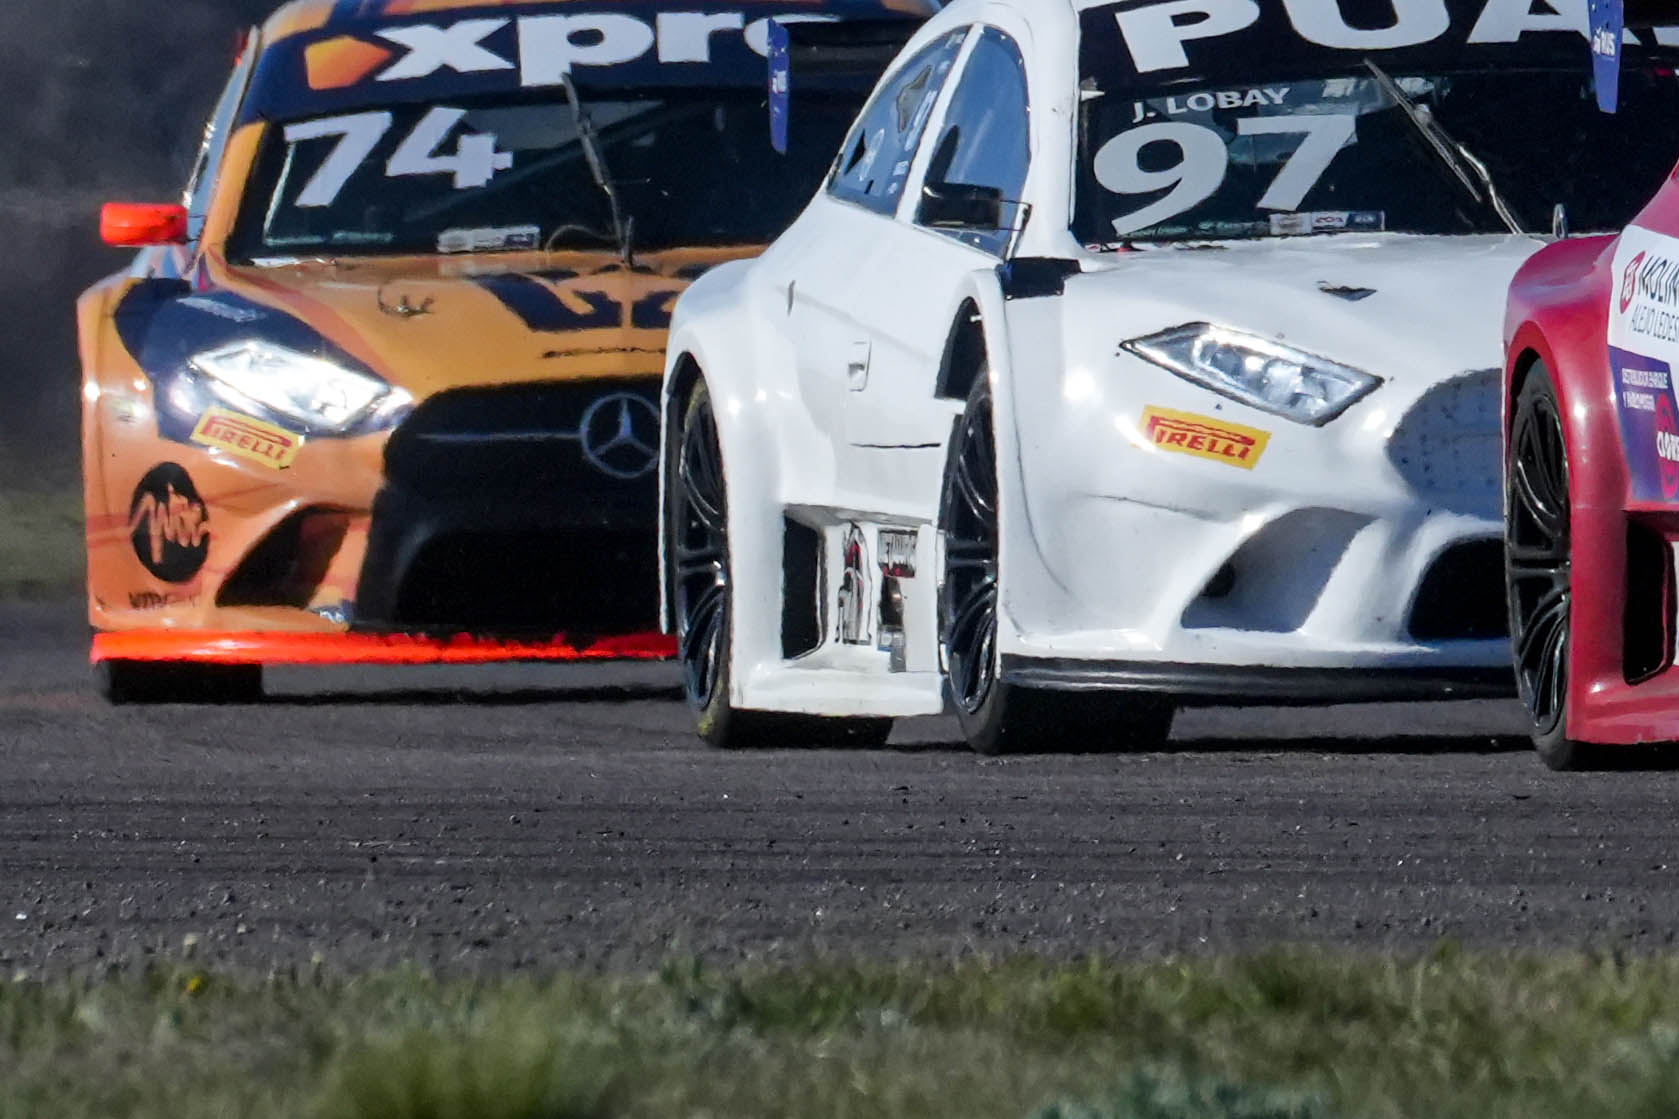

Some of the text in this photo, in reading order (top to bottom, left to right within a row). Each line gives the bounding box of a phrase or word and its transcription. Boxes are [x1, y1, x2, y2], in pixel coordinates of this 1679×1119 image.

[1167, 87, 1291, 115] LOBAY
[283, 108, 512, 208] 74
[1093, 113, 1358, 237] 97
[199, 415, 293, 460] PIRELLI
[1147, 415, 1256, 461] PIRELLI
